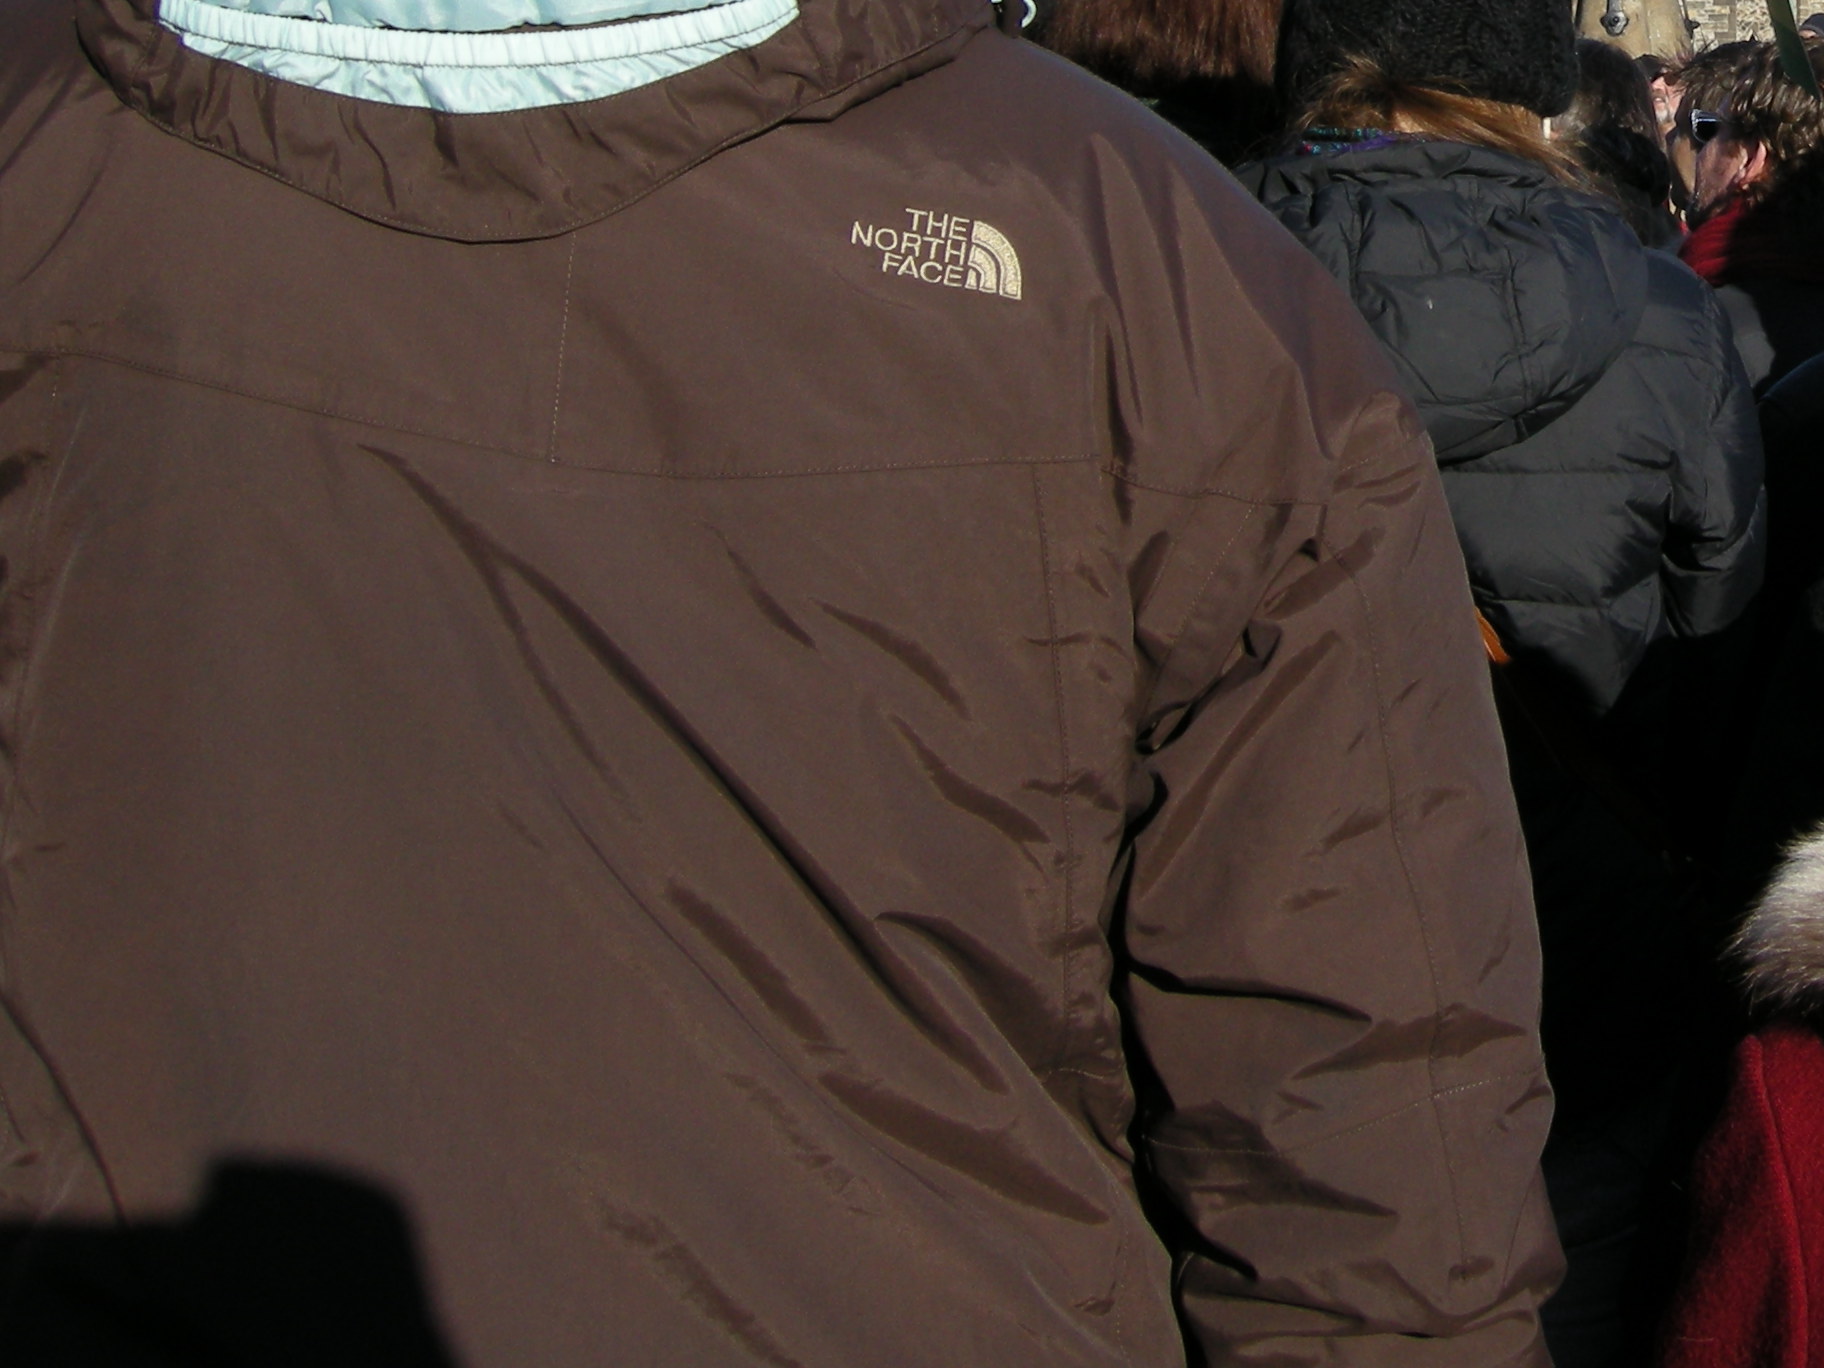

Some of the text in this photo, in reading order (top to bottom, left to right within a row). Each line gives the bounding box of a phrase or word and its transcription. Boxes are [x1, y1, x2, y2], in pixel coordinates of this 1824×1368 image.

[905, 208, 970, 241] THE
[851, 221, 967, 266] NORTH
[882, 252, 964, 288] FACE
